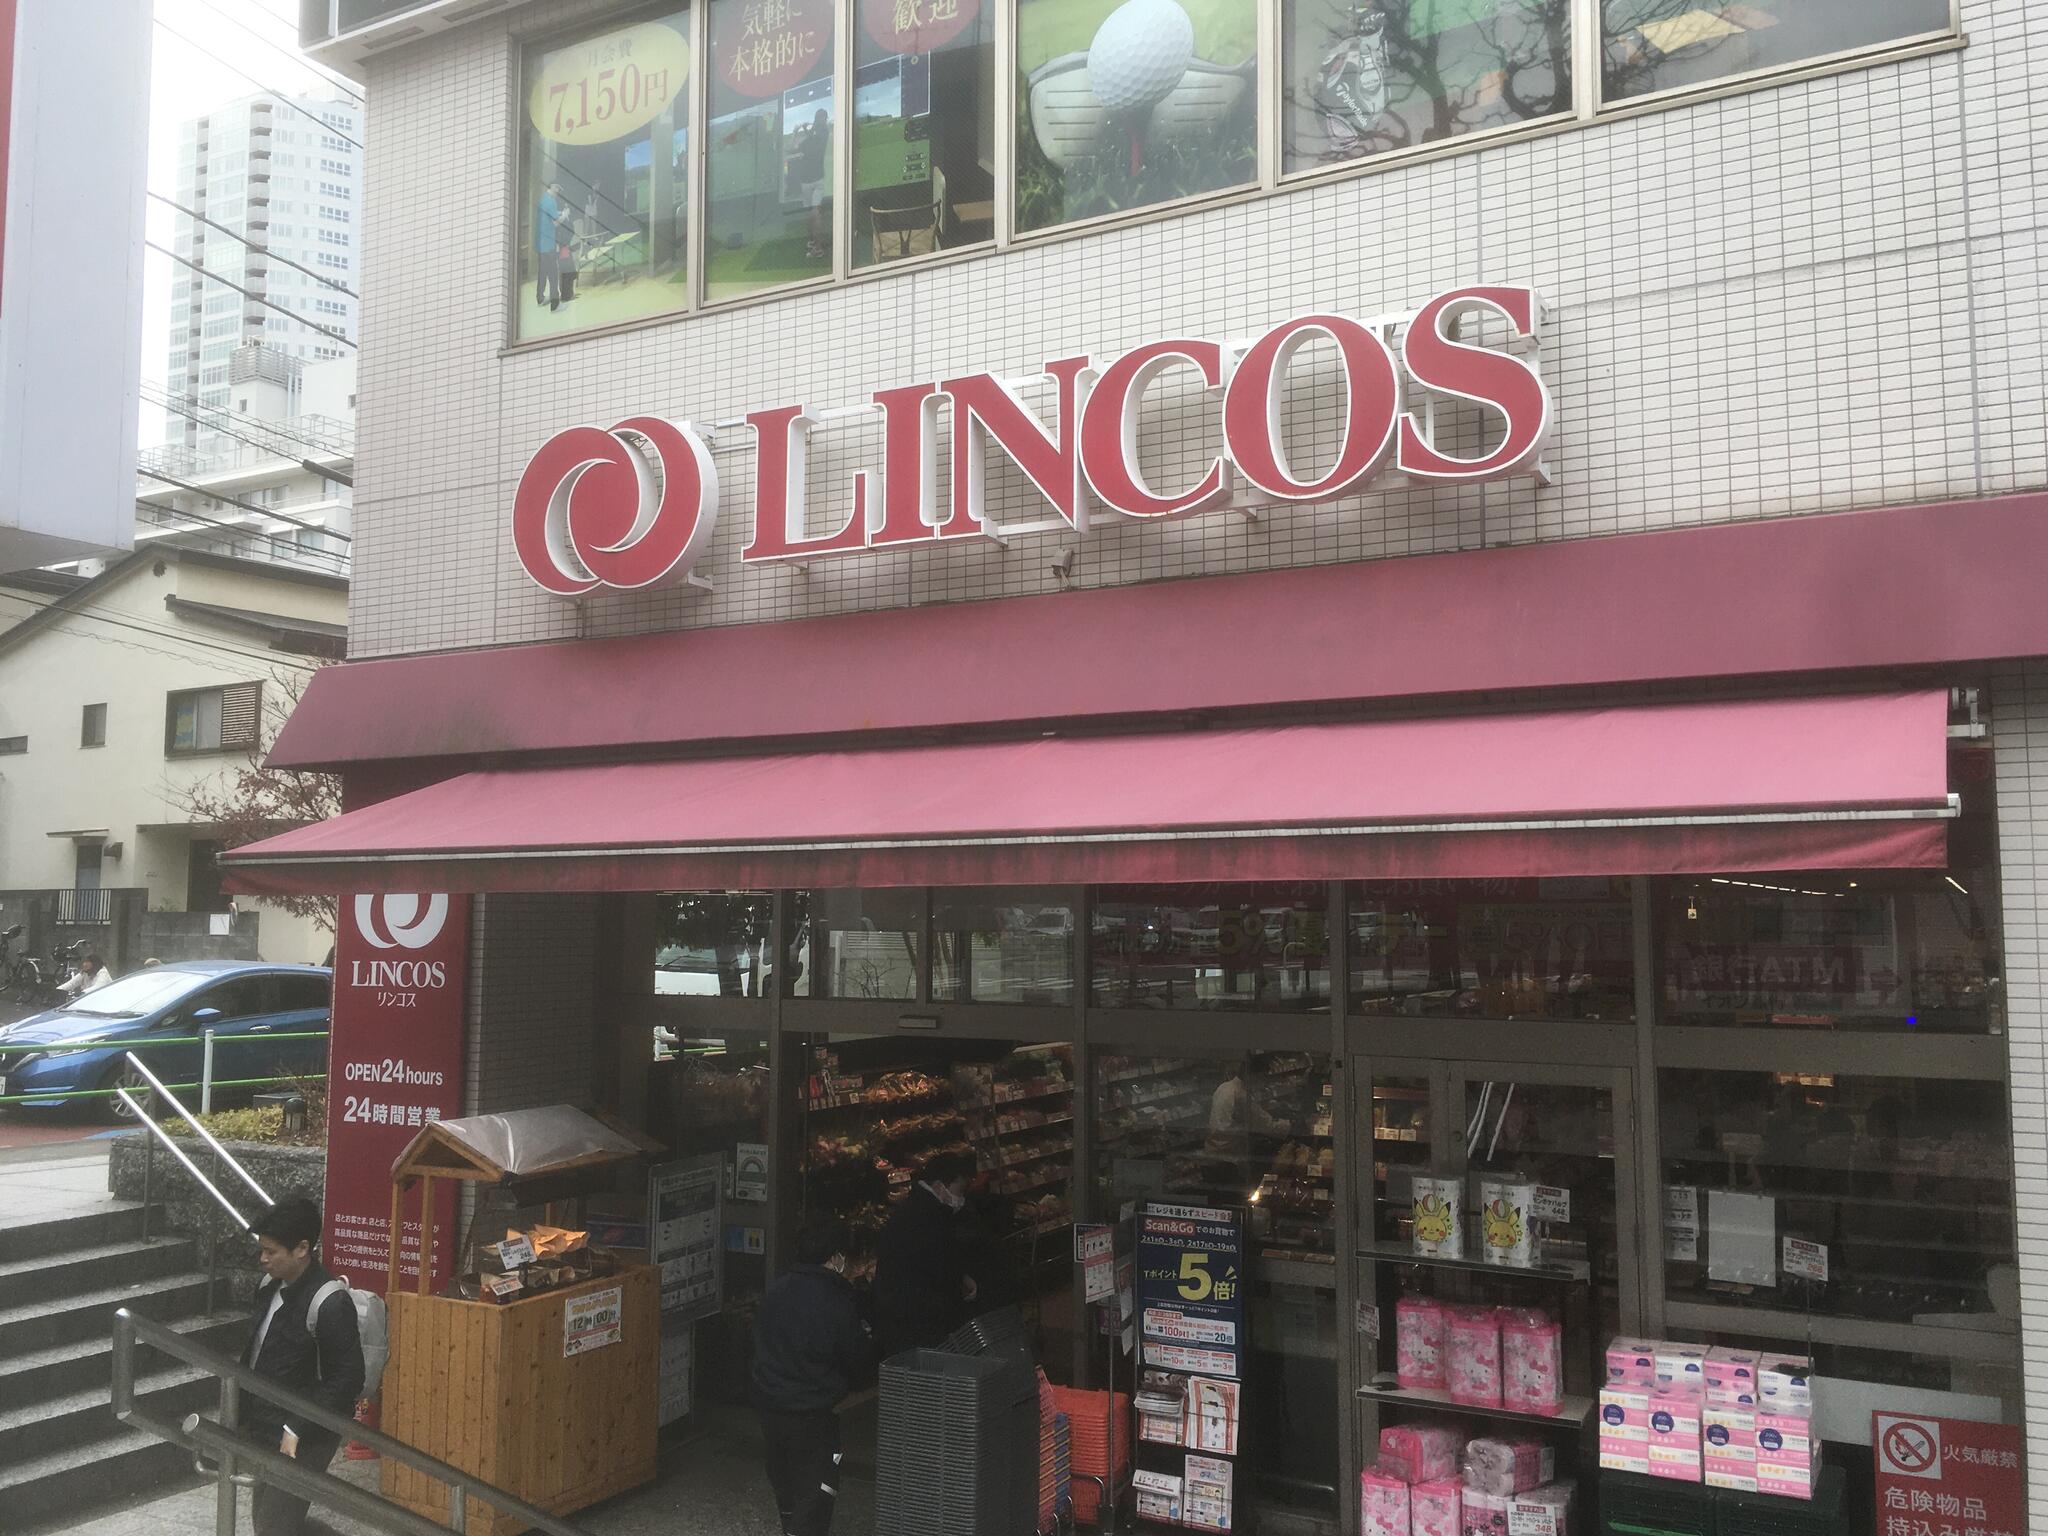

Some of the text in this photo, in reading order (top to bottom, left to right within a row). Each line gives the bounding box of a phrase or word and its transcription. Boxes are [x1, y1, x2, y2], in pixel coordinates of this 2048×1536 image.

[728, 31, 816, 82] 本格的に
[548, 63, 669, 136] 7,150円
[742, 284, 1552, 564] LINCOS
[351, 960, 446, 989] LINCOS
[377, 992, 417, 1007] リンコス
[343, 1096, 442, 1128] 24時間営業
[1145, 1219, 1194, 1234] Scan&Go
[1944, 1444, 2018, 1470] 火気厳禁
[1885, 1486, 1987, 1522] 危険物品
